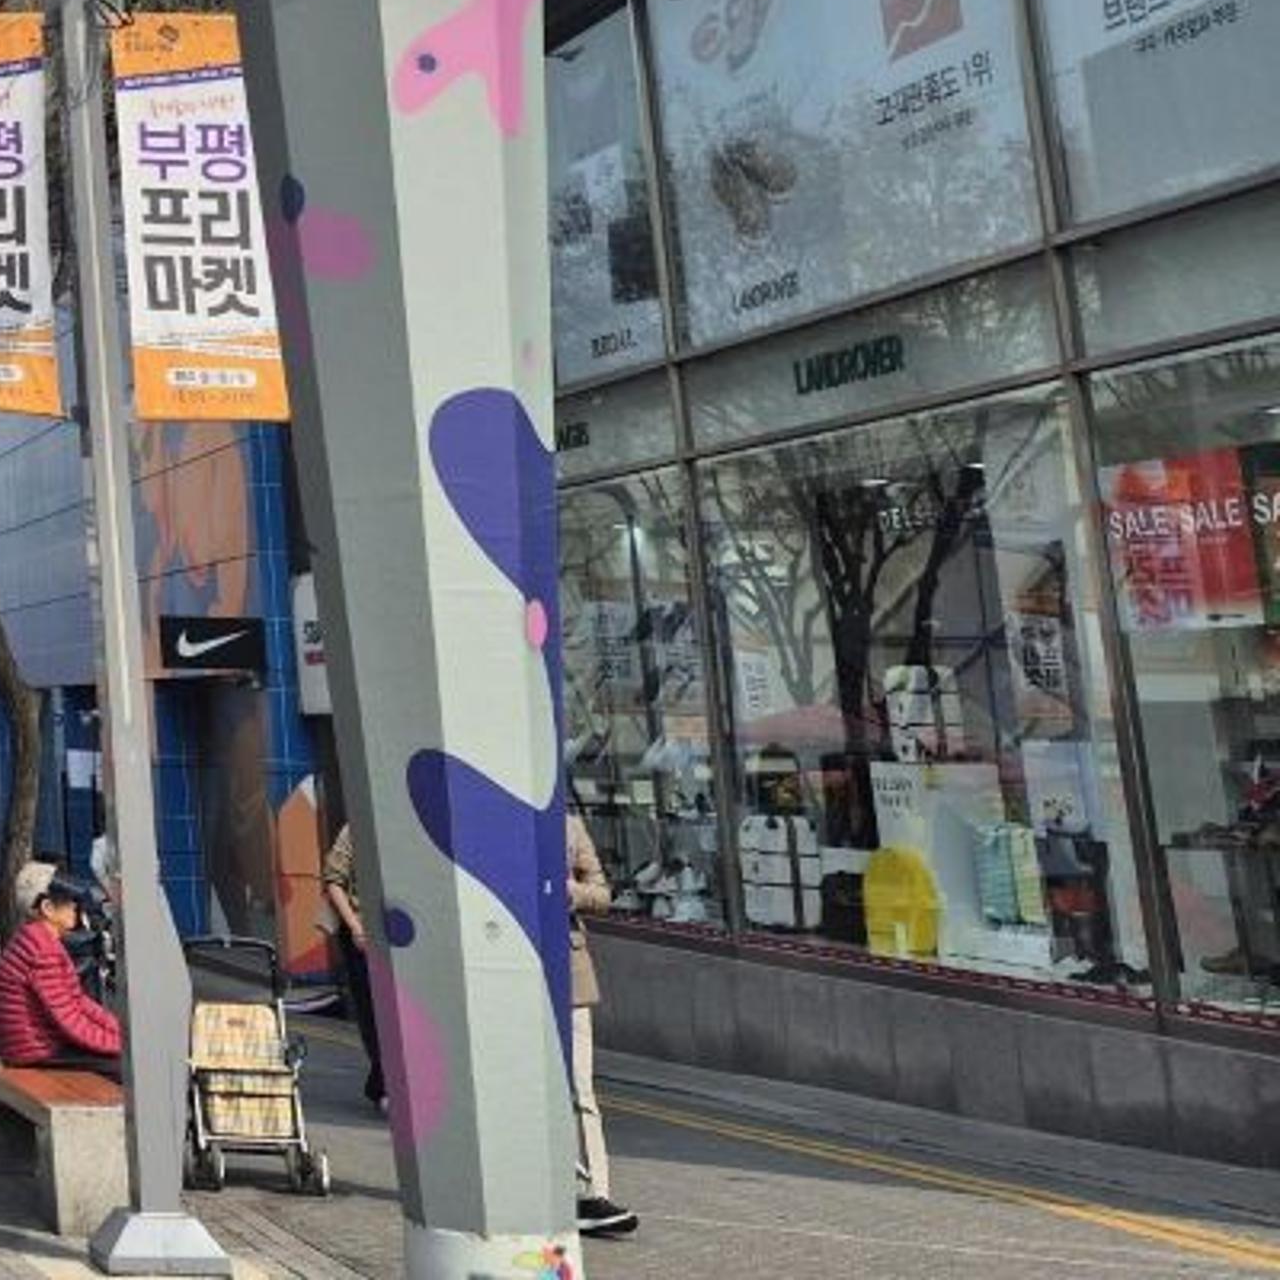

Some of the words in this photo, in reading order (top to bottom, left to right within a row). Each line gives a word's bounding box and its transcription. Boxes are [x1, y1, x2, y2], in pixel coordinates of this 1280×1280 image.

[138, 122, 248, 183] 부평
[139, 187, 252, 250] 프리
[144, 254, 260, 317] 마켓
[1109, 505, 1170, 539] SALE
[1180, 497, 1243, 533] SALE
